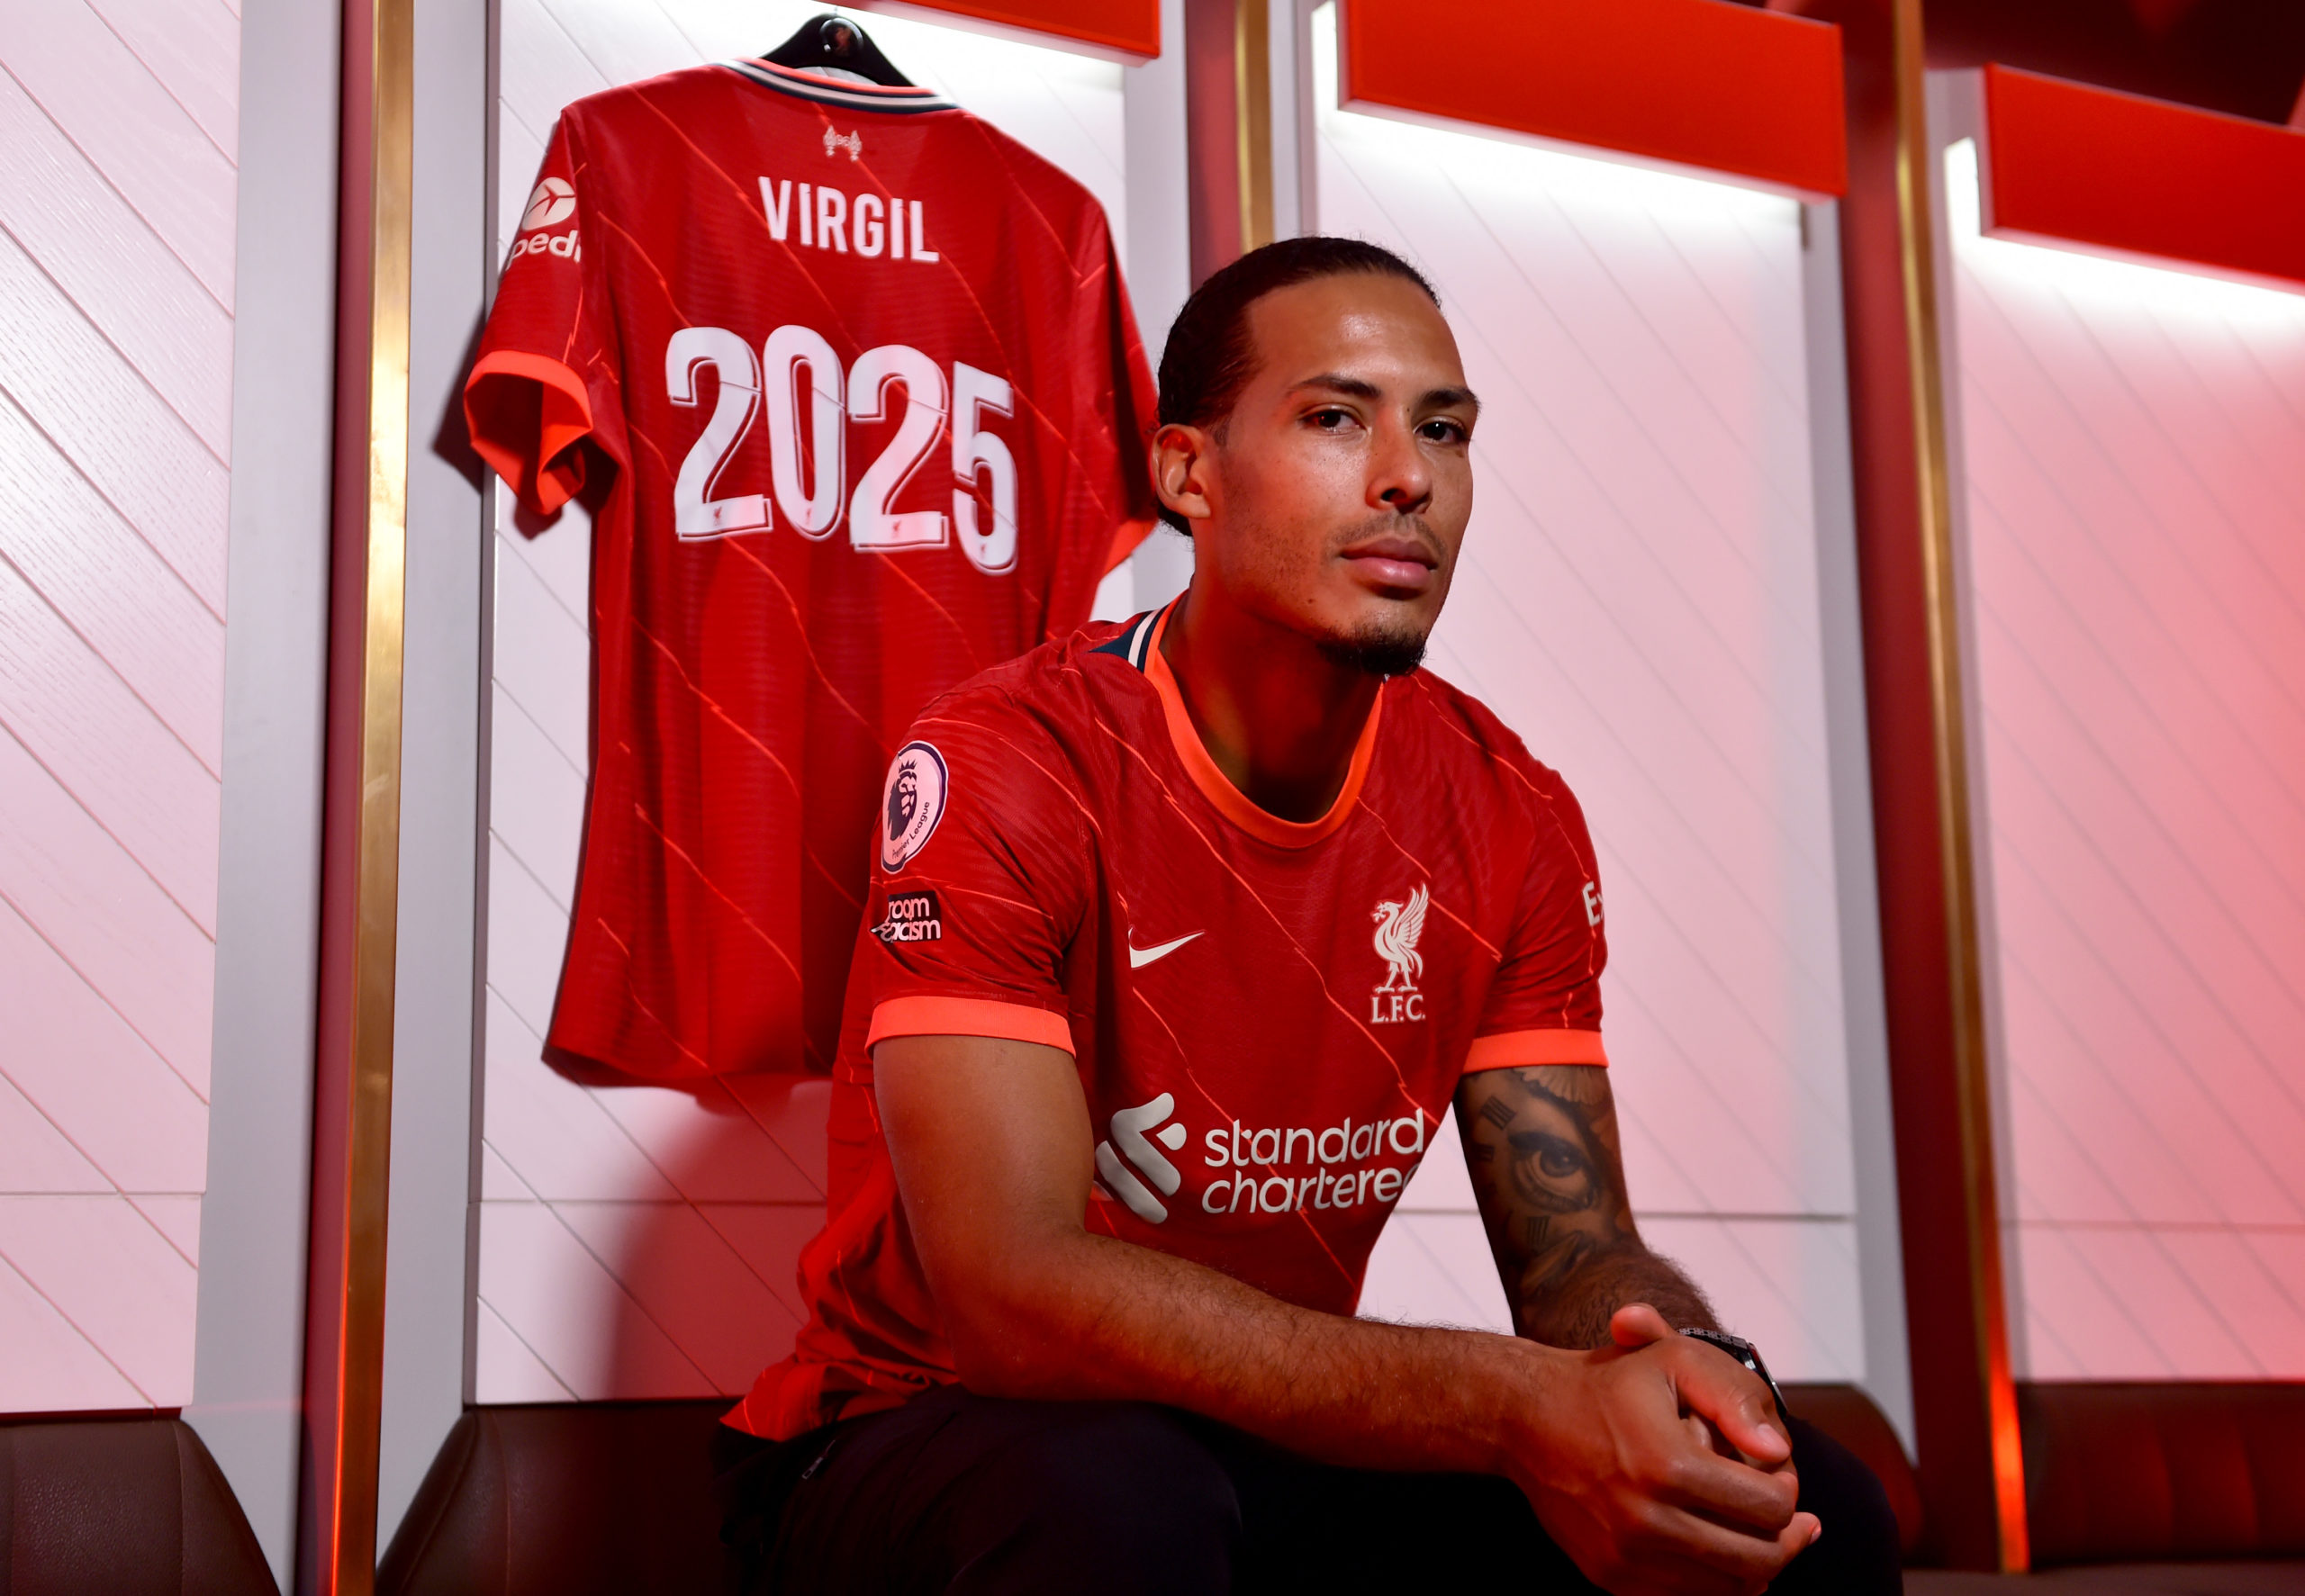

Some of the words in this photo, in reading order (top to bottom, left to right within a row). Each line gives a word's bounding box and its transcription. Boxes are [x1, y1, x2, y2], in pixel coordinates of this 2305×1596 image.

[758, 176, 939, 263] VIRGIL
[665, 324, 1019, 576] 2025
[908, 801, 930, 840] League
[888, 897, 930, 921] room
[1370, 993, 1426, 1023] L.F.C.
[1205, 1106, 1424, 1168] standard
